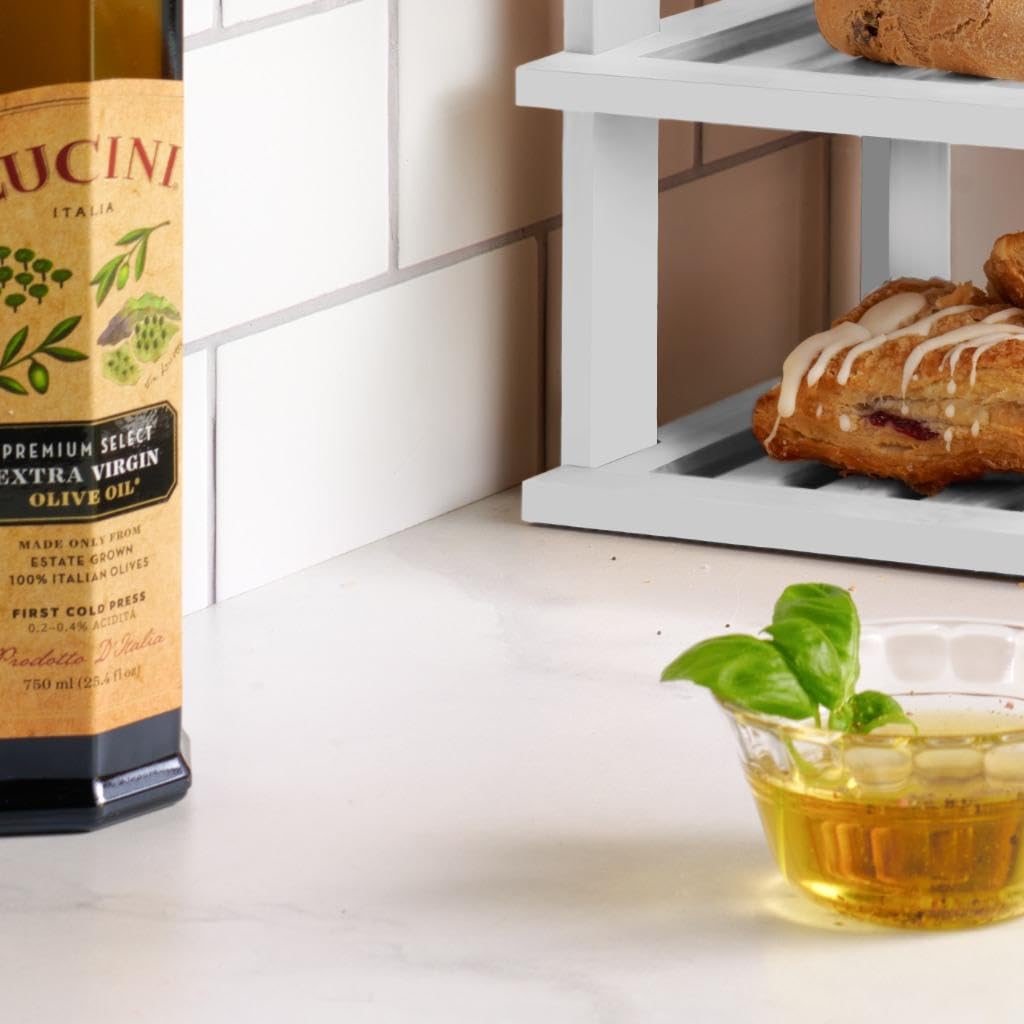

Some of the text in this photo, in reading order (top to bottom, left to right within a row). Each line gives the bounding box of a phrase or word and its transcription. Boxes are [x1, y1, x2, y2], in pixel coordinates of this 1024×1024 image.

[0, 134, 182, 200] UCINI
[53, 202, 114, 218] ITALIA
[3, 425, 153, 459] PREMIUM SELECT
[0, 448, 160, 485] EXTRA VIRGIN
[29, 489, 100, 508] OLIVE
[19, 525, 142, 550] MADE ONLY FROM
[31, 544, 134, 568] ESTATE GROWN
[9, 556, 149, 586] 100% ITALIAN OLIVES
[12, 591, 147, 619] FIRST COLD PRESS
[0, 647, 87, 667] Prodotto
[23, 678, 51, 691] 750
[55, 677, 73, 690] ml
